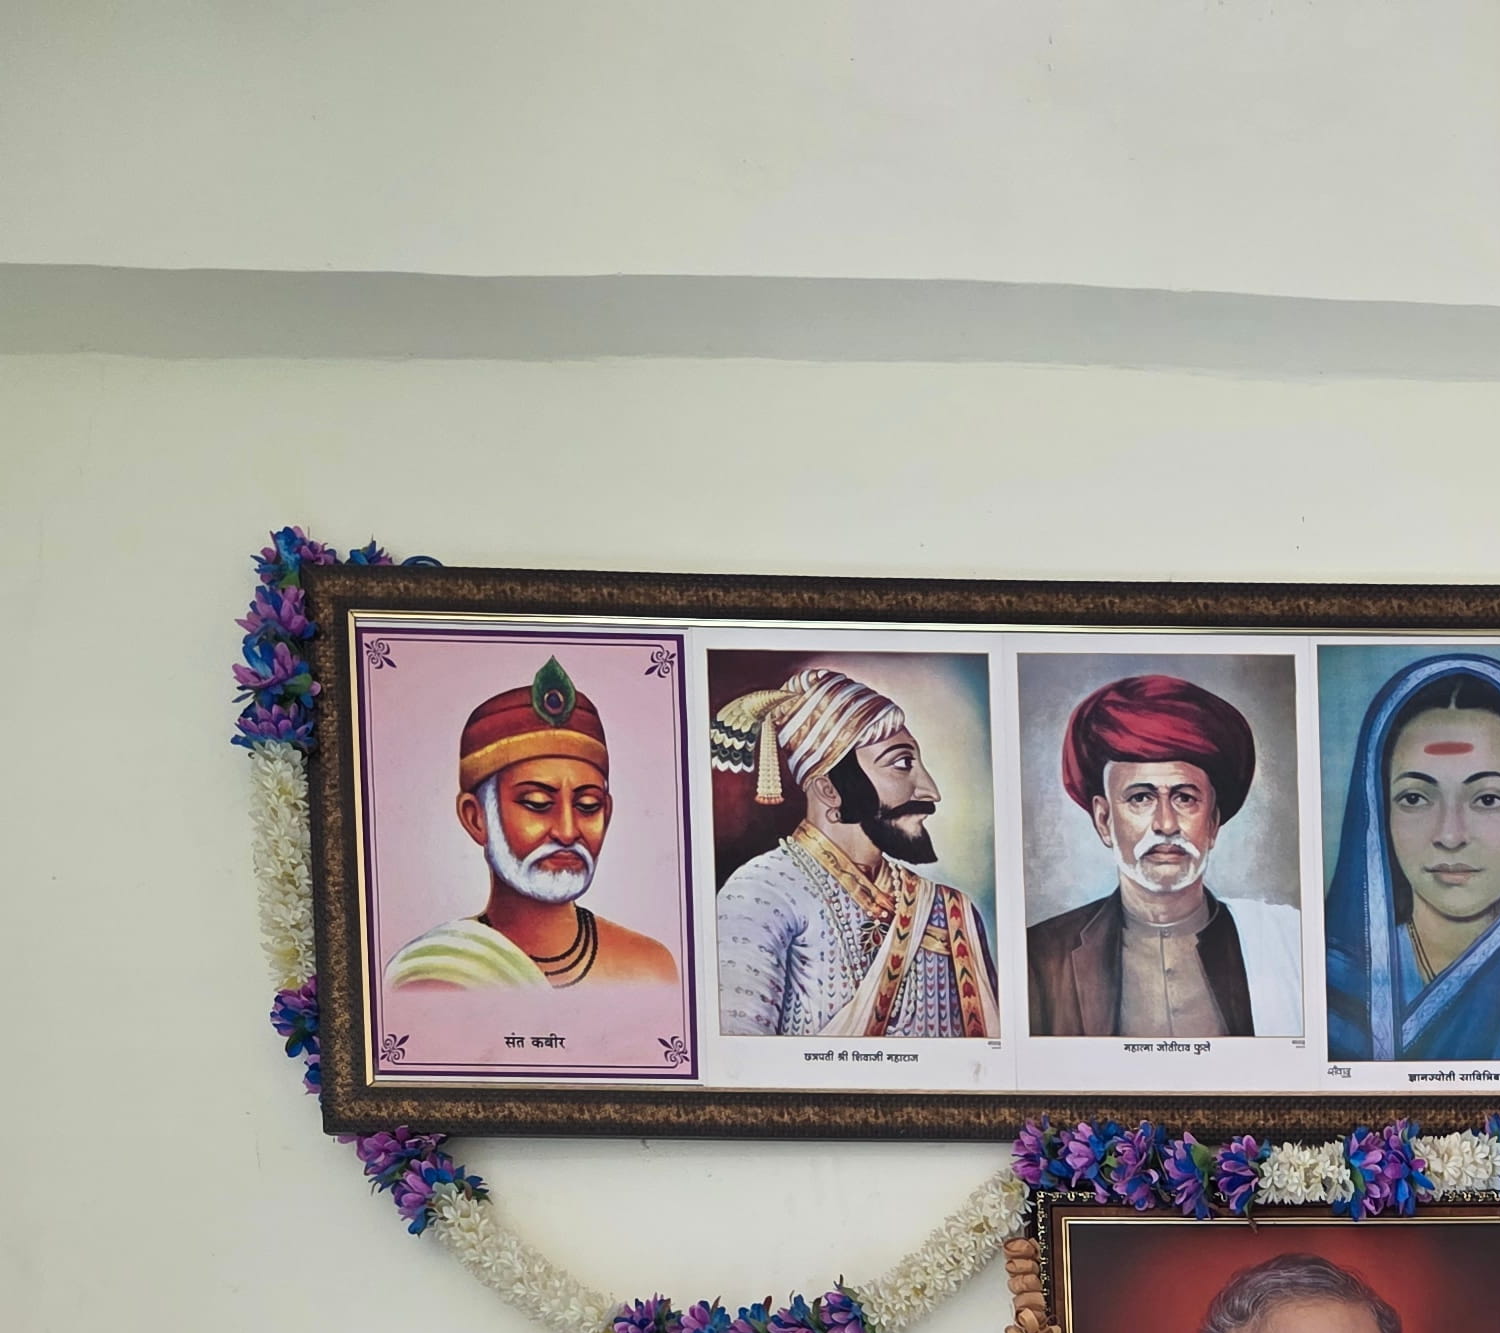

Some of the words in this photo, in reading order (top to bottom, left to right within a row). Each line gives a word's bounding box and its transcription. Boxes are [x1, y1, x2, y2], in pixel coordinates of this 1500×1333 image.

[504, 1034, 525, 1049] संत
[1123, 1043, 1153, 1053] महात्मा
[1194, 1041, 1210, 1055] फुले
[804, 1050, 834, 1062] छत्रपती
[838, 1050, 848, 1062] श्री
[852, 1050, 883, 1062] शिवाजी
[886, 1054, 919, 1063] महाराज
